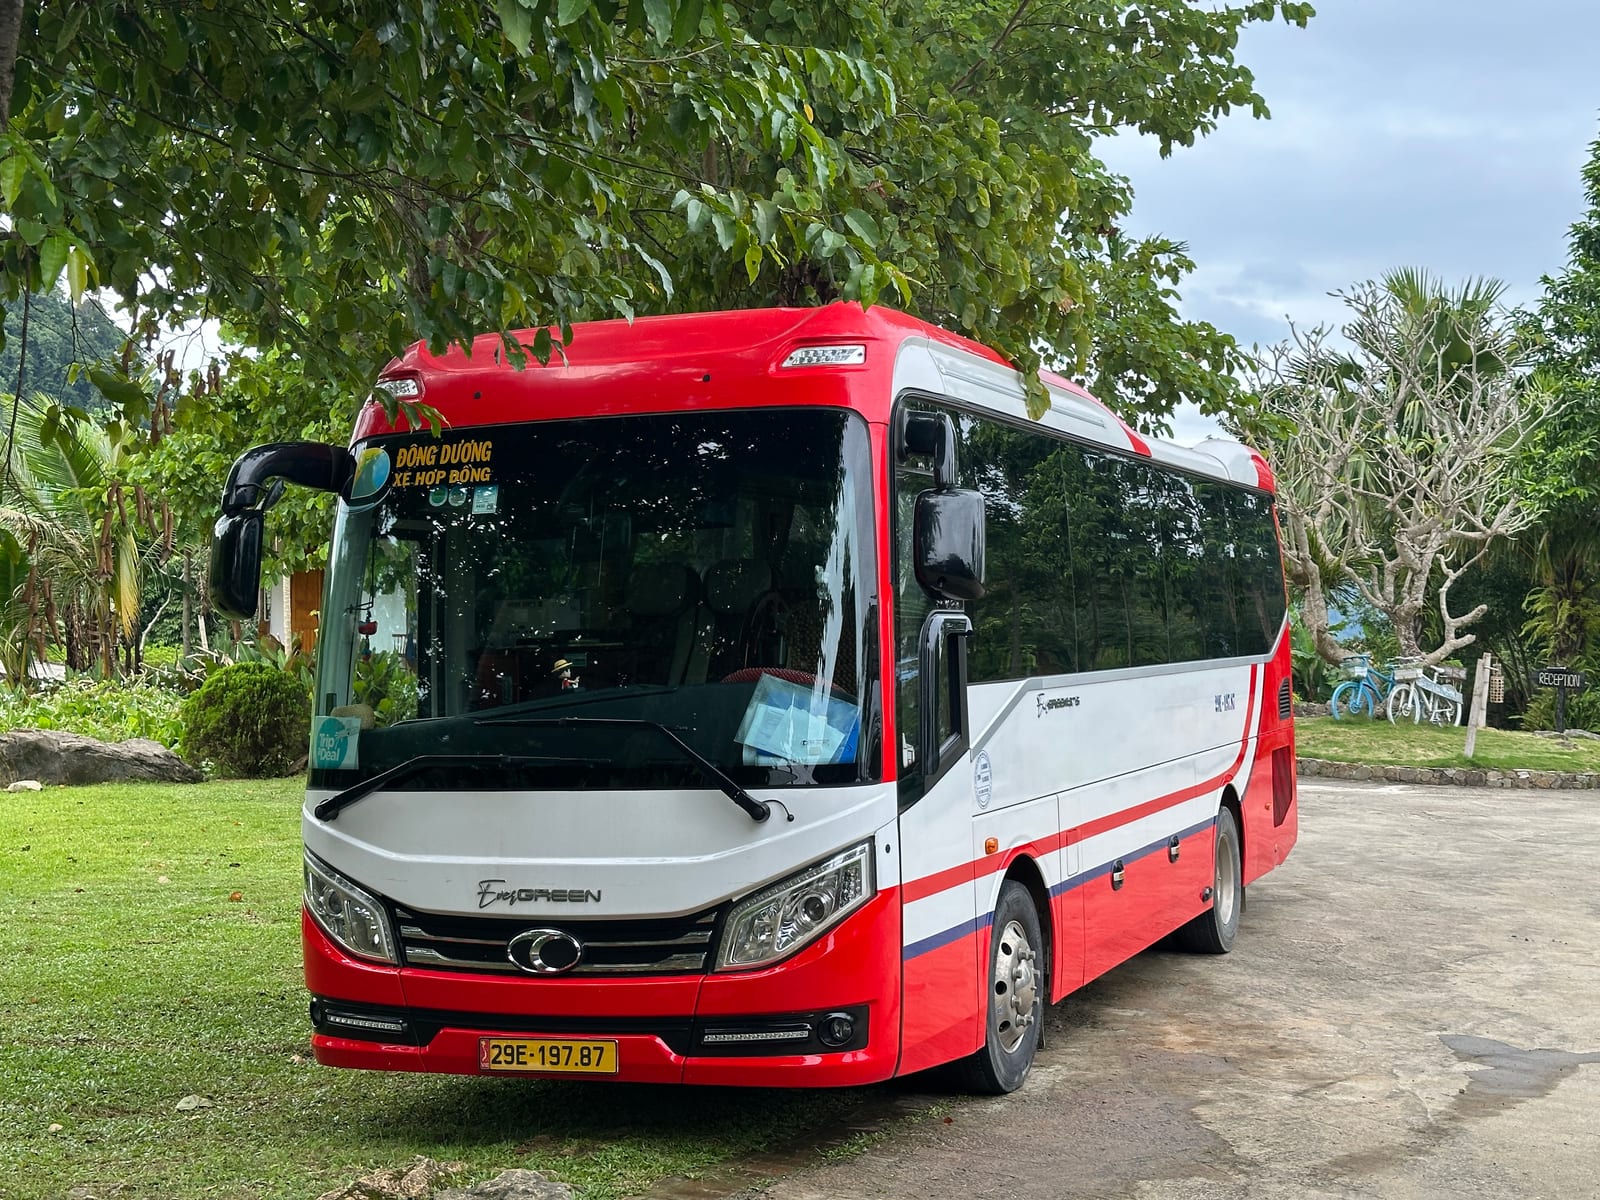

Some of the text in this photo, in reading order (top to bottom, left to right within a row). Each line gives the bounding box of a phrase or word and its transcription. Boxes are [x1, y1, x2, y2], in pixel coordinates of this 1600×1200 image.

[396, 439, 493, 468] ĐÔNG DƯƠNG
[392, 471, 412, 487] XE
[1538, 672, 1580, 687] RECEPTION
[319, 733, 335, 750] Trip
[491, 1044, 604, 1067] 29E-197.87
